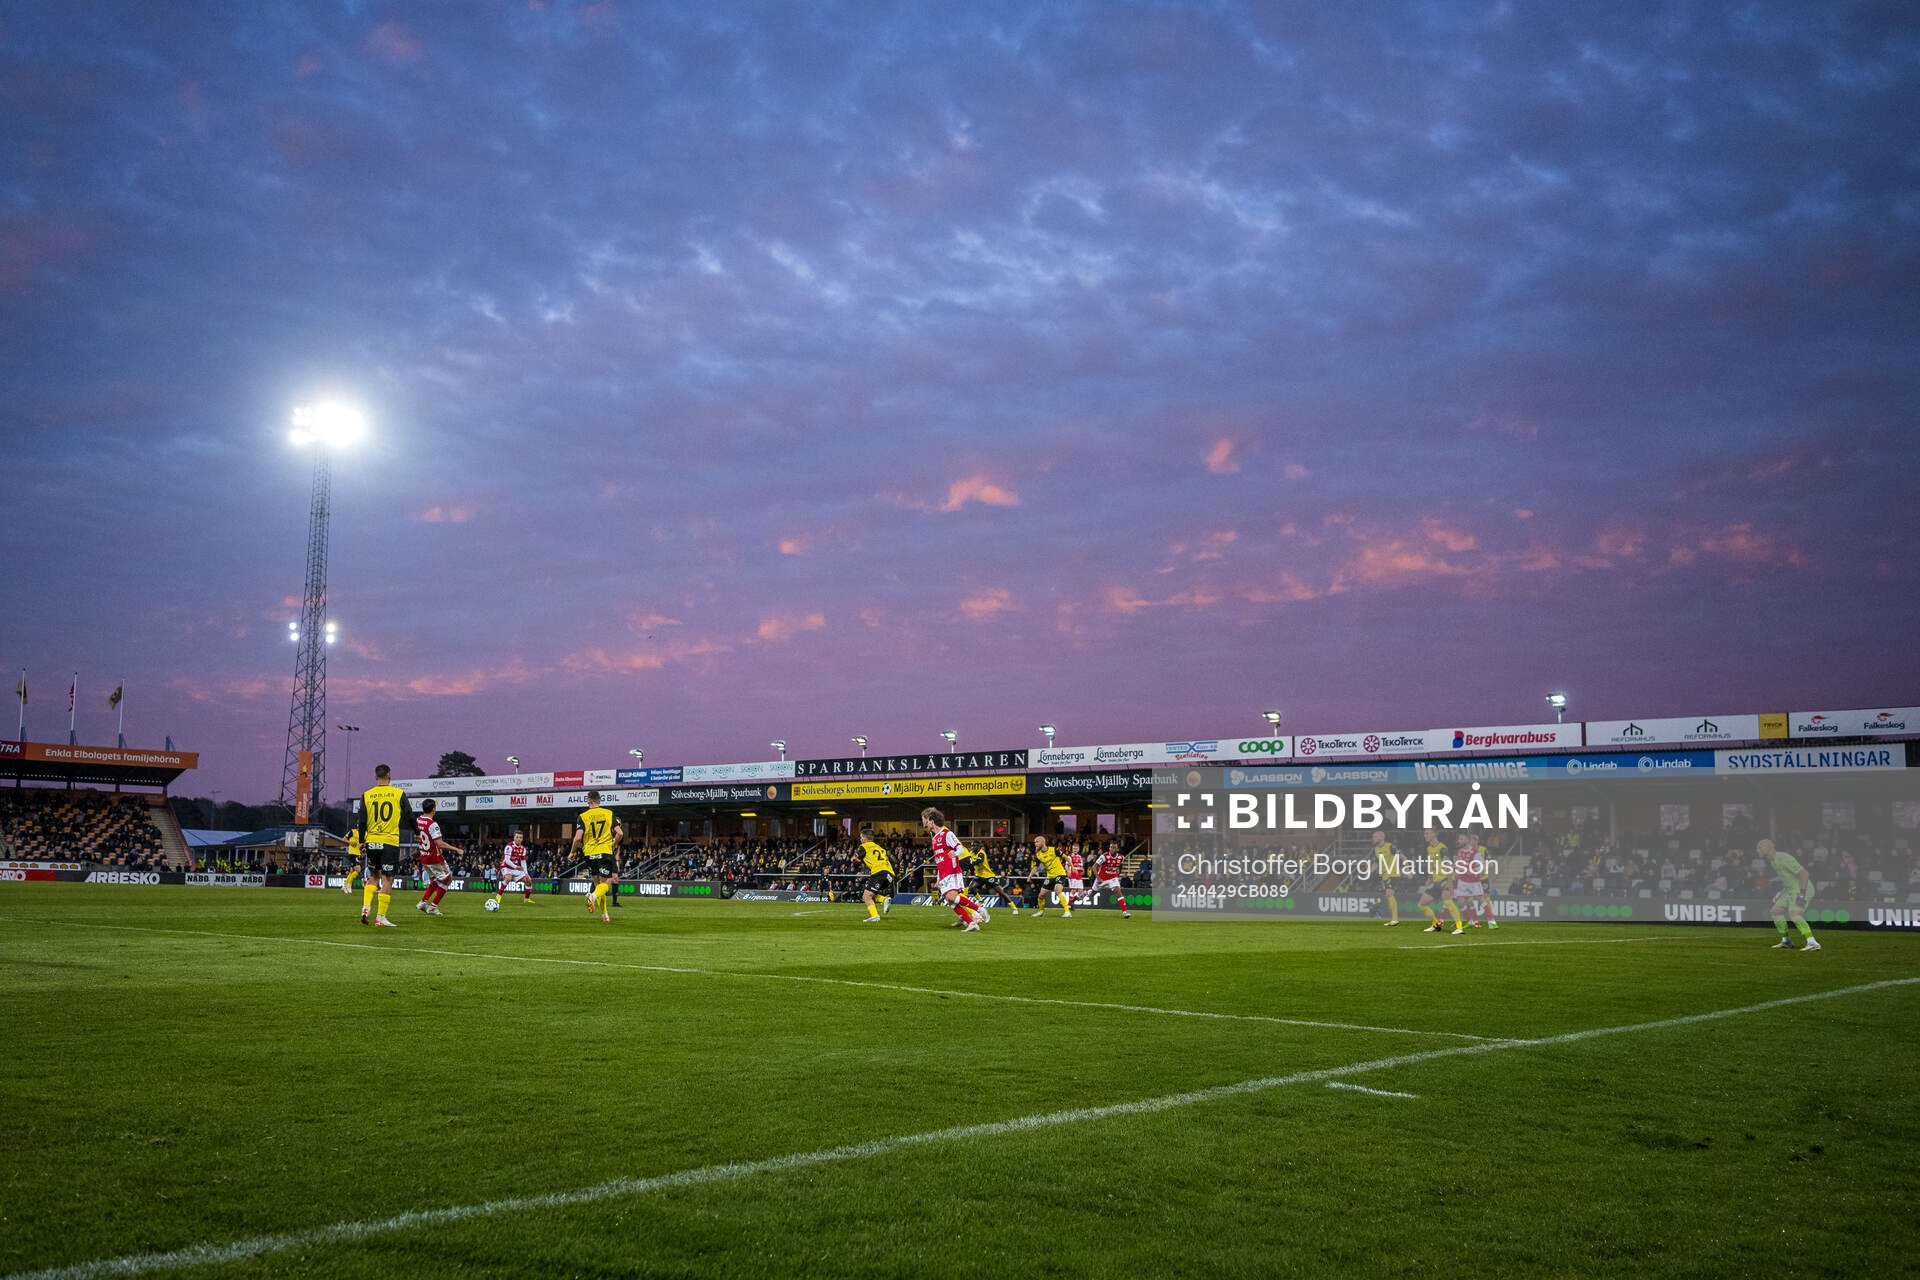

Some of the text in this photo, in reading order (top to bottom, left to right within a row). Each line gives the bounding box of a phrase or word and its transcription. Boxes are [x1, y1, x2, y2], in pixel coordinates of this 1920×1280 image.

[1798, 724, 1838, 732] Falkeskog
[1864, 722, 1905, 730] Falkeskog
[1238, 740, 1284, 754] coop
[1465, 732, 1556, 748] Bergkvarabuss
[46, 748, 180, 764] Enkla Elbolagets familjehörna
[1038, 750, 1084, 764] Lönneberga
[1094, 747, 1144, 762] Lönneberga
[1728, 750, 1890, 770] SYDSTÄLLNINGAR
[798, 753, 1026, 775] SPARBANKSLÄKTAREN
[1584, 761, 1618, 771] Lindab
[1656, 758, 1692, 768] Lindab
[1246, 773, 1302, 782] LARSSON
[1327, 770, 1388, 780] LARSSON
[1414, 762, 1530, 781] NORRVIDINGE
[802, 785, 844, 796] Sölvesborgs
[846, 783, 880, 794] kommun
[894, 782, 925, 794] Mjällby
[954, 780, 1009, 792] hemmaplan
[1044, 774, 1178, 790] Sölvesborg-Mjällby Sparbank
[672, 788, 762, 800] Sölvesborg-Mjällby Sparbank
[372, 802, 394, 822] 10
[590, 820, 606, 838] 17
[85, 872, 160, 884] ARBESKO
[640, 884, 672, 895] UNIBET
[1664, 904, 1746, 922] UNIBET
